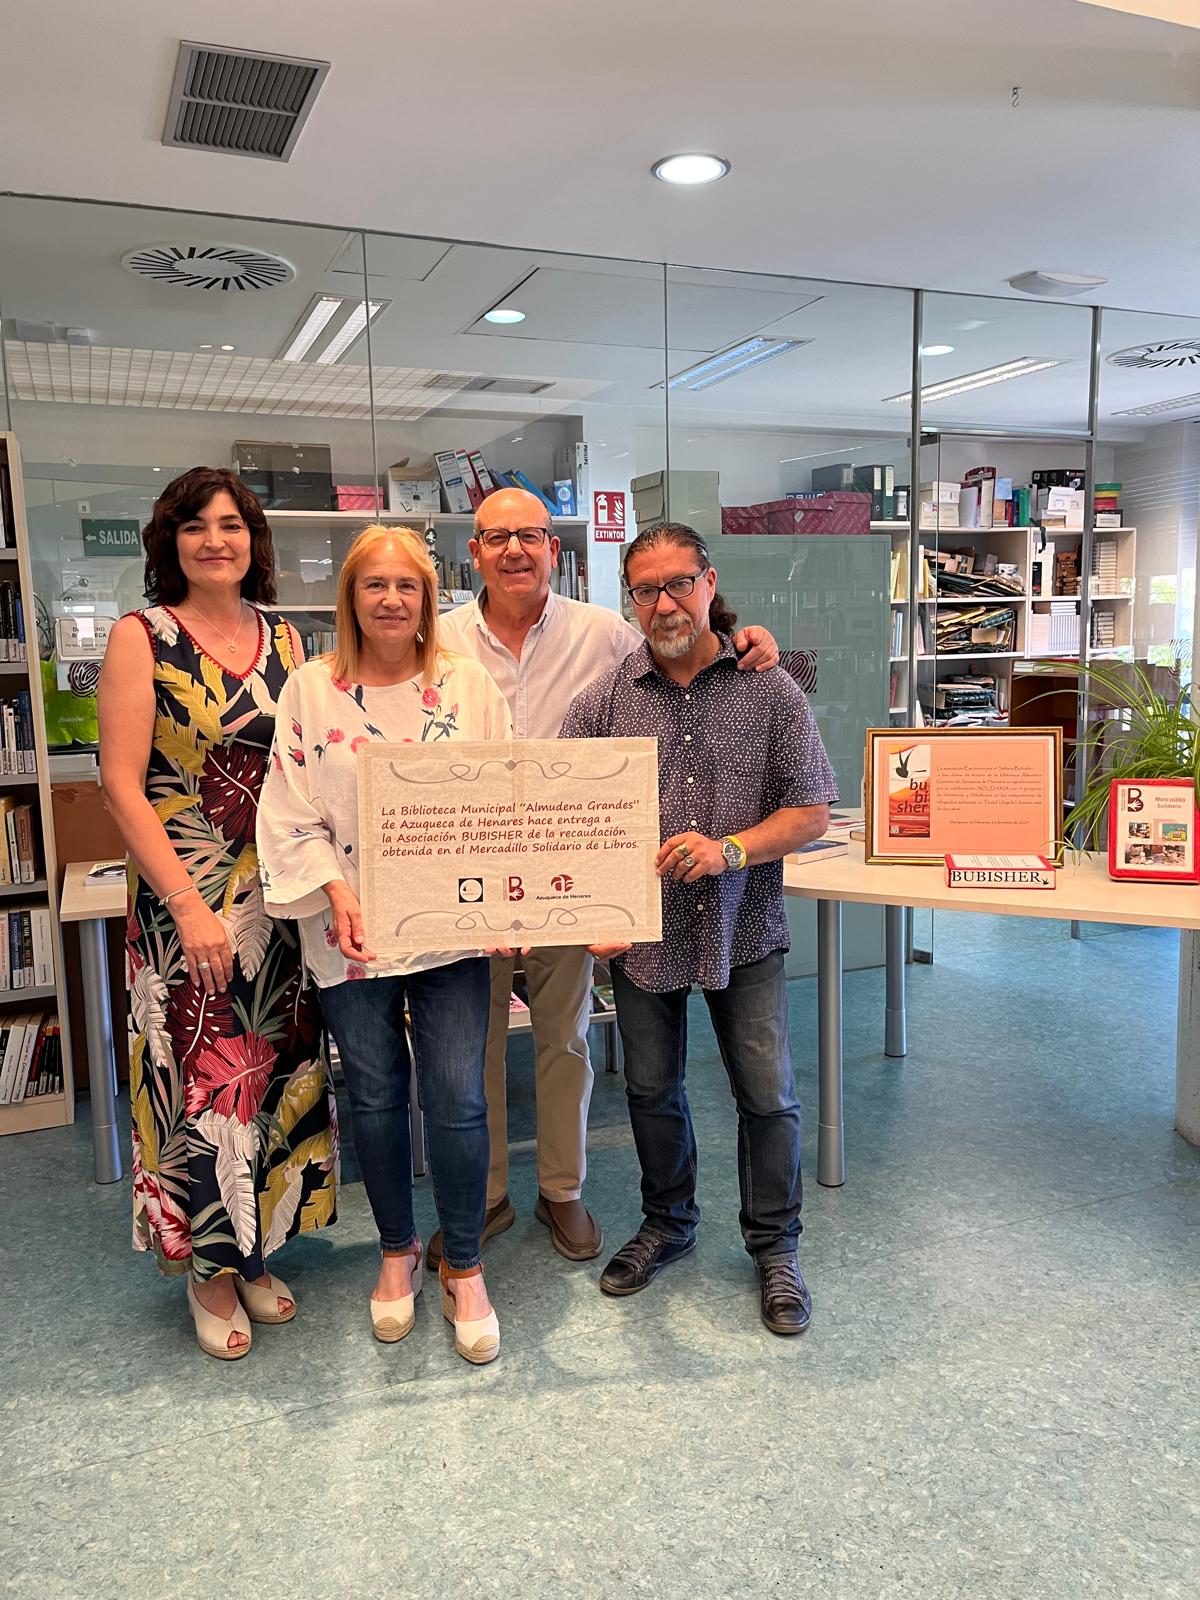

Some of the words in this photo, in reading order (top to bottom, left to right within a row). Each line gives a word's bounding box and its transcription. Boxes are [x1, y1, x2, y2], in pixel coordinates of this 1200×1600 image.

[99, 530, 139, 545] SALIDA
[595, 530, 625, 540] EXTINTOR
[909, 778, 928, 791] bu
[914, 790, 929, 803] bi
[381, 807, 396, 816] La
[401, 805, 456, 816] Biblioteca
[461, 803, 516, 816] Municipal
[896, 800, 928, 813] sher
[381, 820, 396, 830] de
[400, 820, 455, 831] Azuqueca
[459, 818, 473, 828] de
[477, 817, 524, 828] Henares
[528, 816, 553, 826] hace
[557, 815, 600, 827] entrega
[604, 816, 611, 824] a
[382, 833, 392, 843] la
[396, 831, 457, 843] Asociación
[461, 830, 523, 842] BUBISHER
[527, 829, 541, 839] de
[545, 828, 555, 838] la
[560, 826, 627, 838] recaudación
[382, 846, 432, 857] obtenida
[437, 847, 451, 855] en
[455, 845, 465, 855] el
[469, 843, 528, 855] Mercadillo
[532, 841, 581, 853] Solidario
[585, 840, 599, 850] de
[603, 839, 640, 850] Libros.
[951, 870, 1041, 883] BUBISHER
